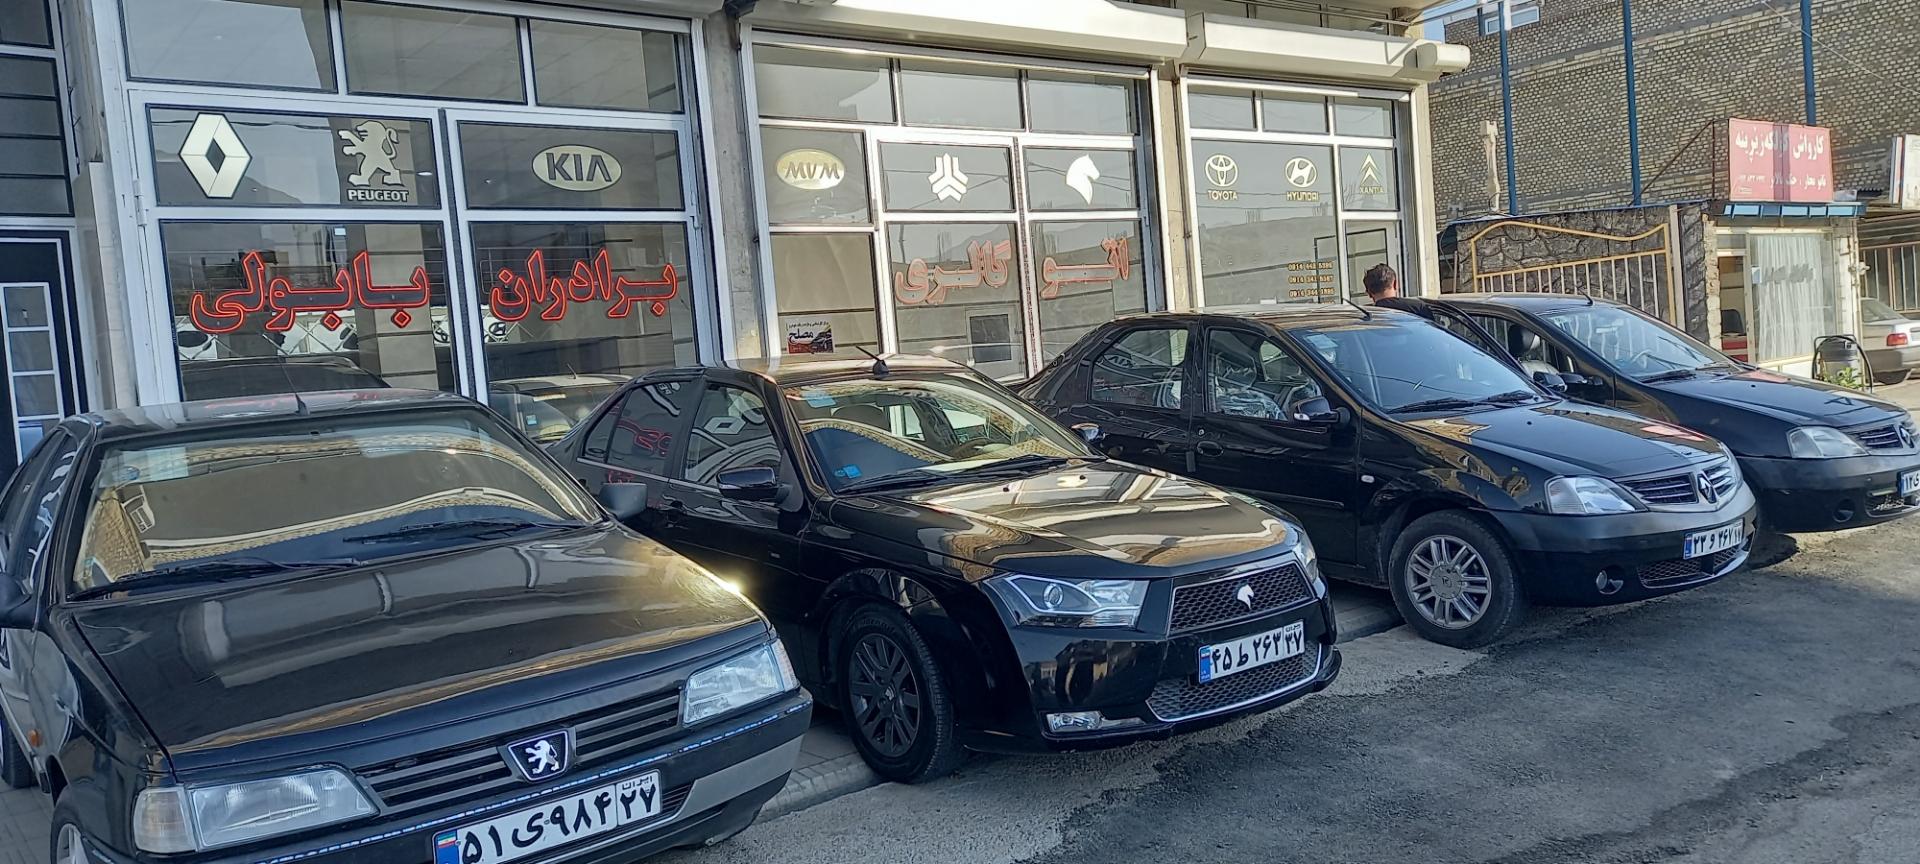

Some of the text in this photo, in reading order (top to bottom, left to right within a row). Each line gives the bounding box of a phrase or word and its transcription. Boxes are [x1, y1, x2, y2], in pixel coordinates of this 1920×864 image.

[1793, 132, 1824, 160] کارواش
[546, 152, 612, 183] KIA
[785, 161, 840, 180] MVM
[347, 187, 410, 203] PEUGEOT
[1207, 189, 1238, 201] TOYOTA
[1286, 190, 1320, 202] HYUNDAI
[1359, 185, 1384, 195] XANTIA
[189, 236, 1129, 333] اتو گالری برادران بابولی
[1285, 630, 1302, 654] ۳۷
[622, 775, 653, 790] ایران
[619, 783, 657, 820] ۲۷
